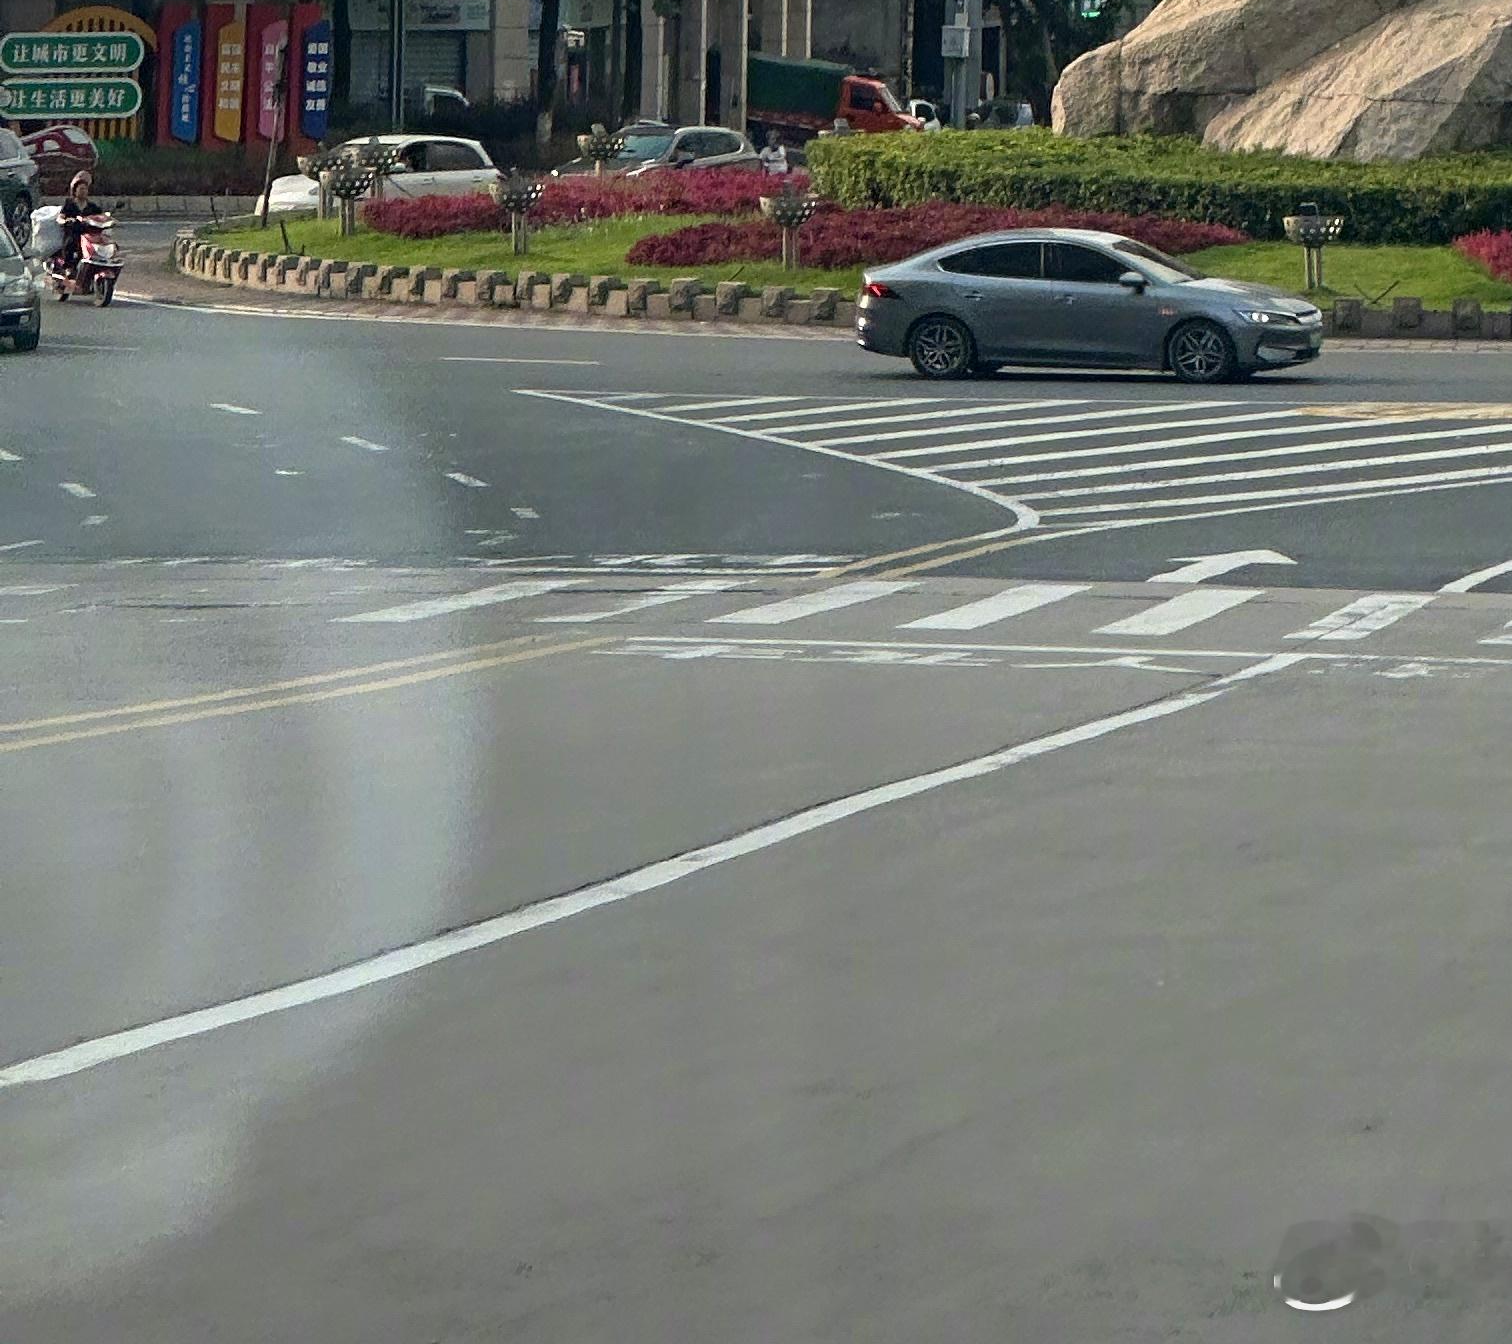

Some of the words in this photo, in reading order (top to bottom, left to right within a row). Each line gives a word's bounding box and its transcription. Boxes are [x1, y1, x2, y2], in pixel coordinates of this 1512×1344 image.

[13, 42, 128, 63] 让城市更文明
